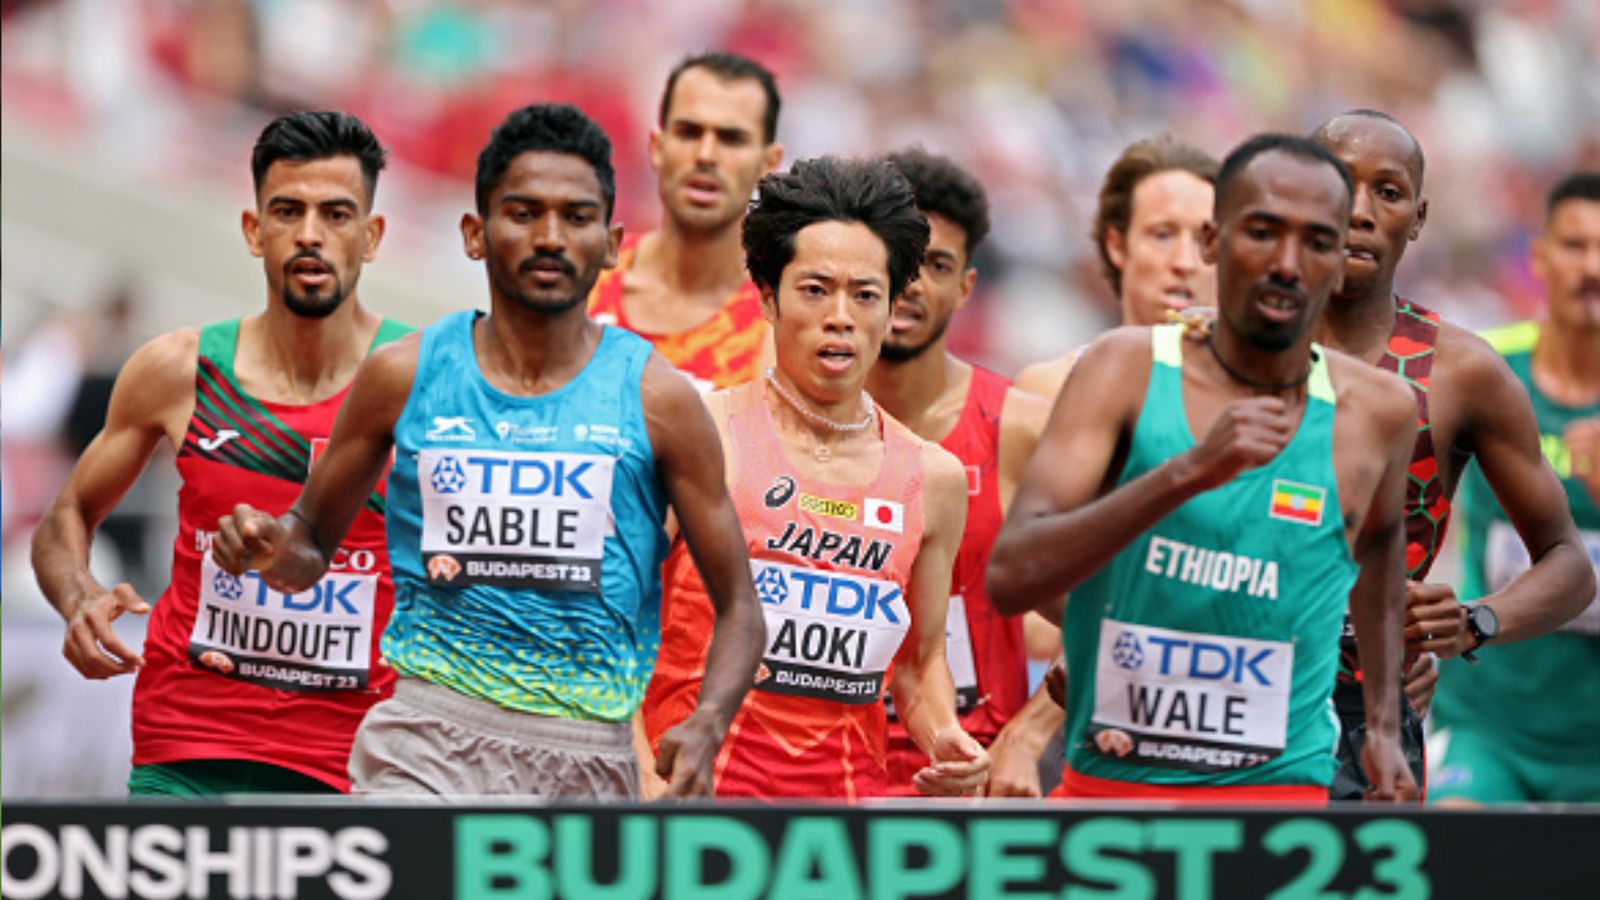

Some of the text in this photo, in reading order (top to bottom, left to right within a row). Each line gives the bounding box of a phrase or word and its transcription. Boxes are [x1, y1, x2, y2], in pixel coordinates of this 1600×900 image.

[467, 456, 595, 499] TDK
[446, 504, 580, 549] SABLE
[767, 522, 892, 571] JAPAN
[1145, 536, 1279, 600] ETHIOPIA
[790, 572, 902, 624] TDK
[206, 604, 361, 661] TINDOUFT
[770, 618, 868, 668] AOKI
[1148, 635, 1276, 686] TDK
[1127, 682, 1248, 736] WALE
